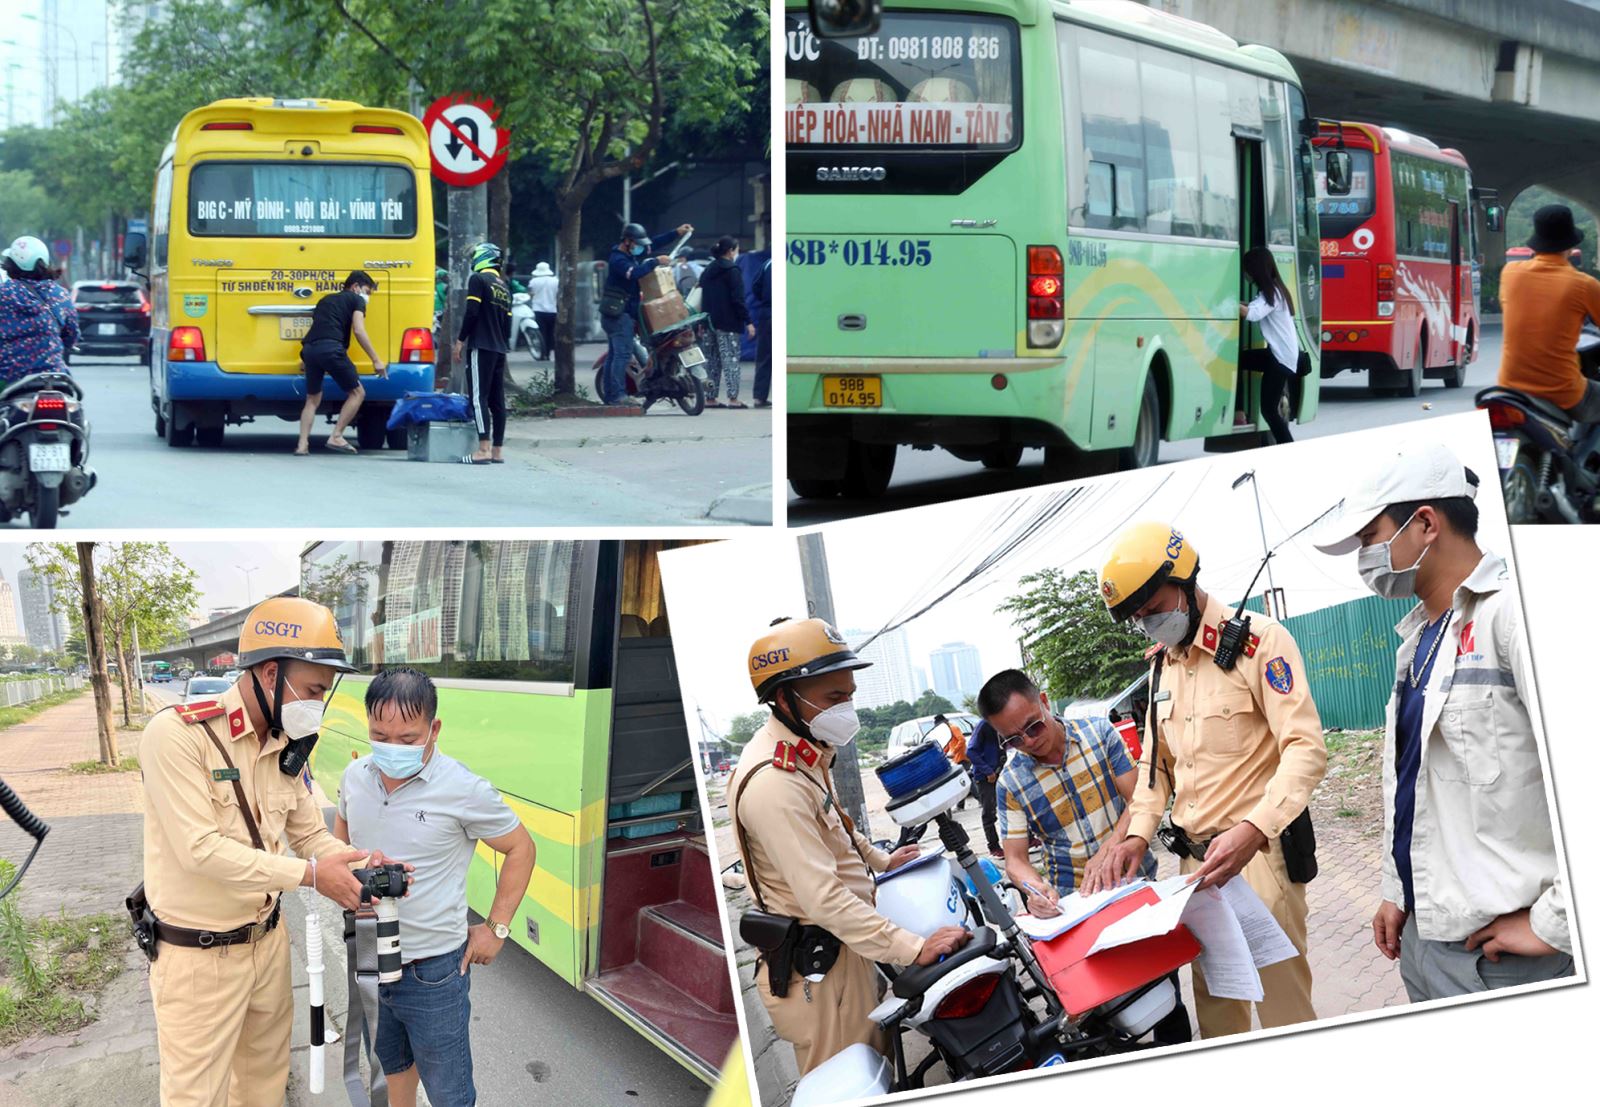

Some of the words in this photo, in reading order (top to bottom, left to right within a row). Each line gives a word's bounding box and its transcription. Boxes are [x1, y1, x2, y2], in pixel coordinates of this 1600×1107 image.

[857, 37, 884, 60] ĐT:
[888, 37, 928, 60] 0981
[931, 36, 963, 59] 808
[968, 37, 999, 60] 836
[910, 110, 952, 144] NAM
[965, 103, 999, 144] TÂN
[816, 167, 887, 181] SAMCO
[197, 200, 217, 219] BIG
[234, 197, 252, 219] MỸ
[256, 197, 284, 219] ĐÌNH
[294, 197, 315, 222] NỘI
[320, 197, 339, 219] BÀI
[349, 198, 376, 220] VĨNH
[381, 198, 403, 220] YÊN
[839, 379, 865, 391] 98B
[829, 392, 876, 405] 014.95
[254, 621, 302, 639] CSGT
[751, 648, 790, 671] CSGT
